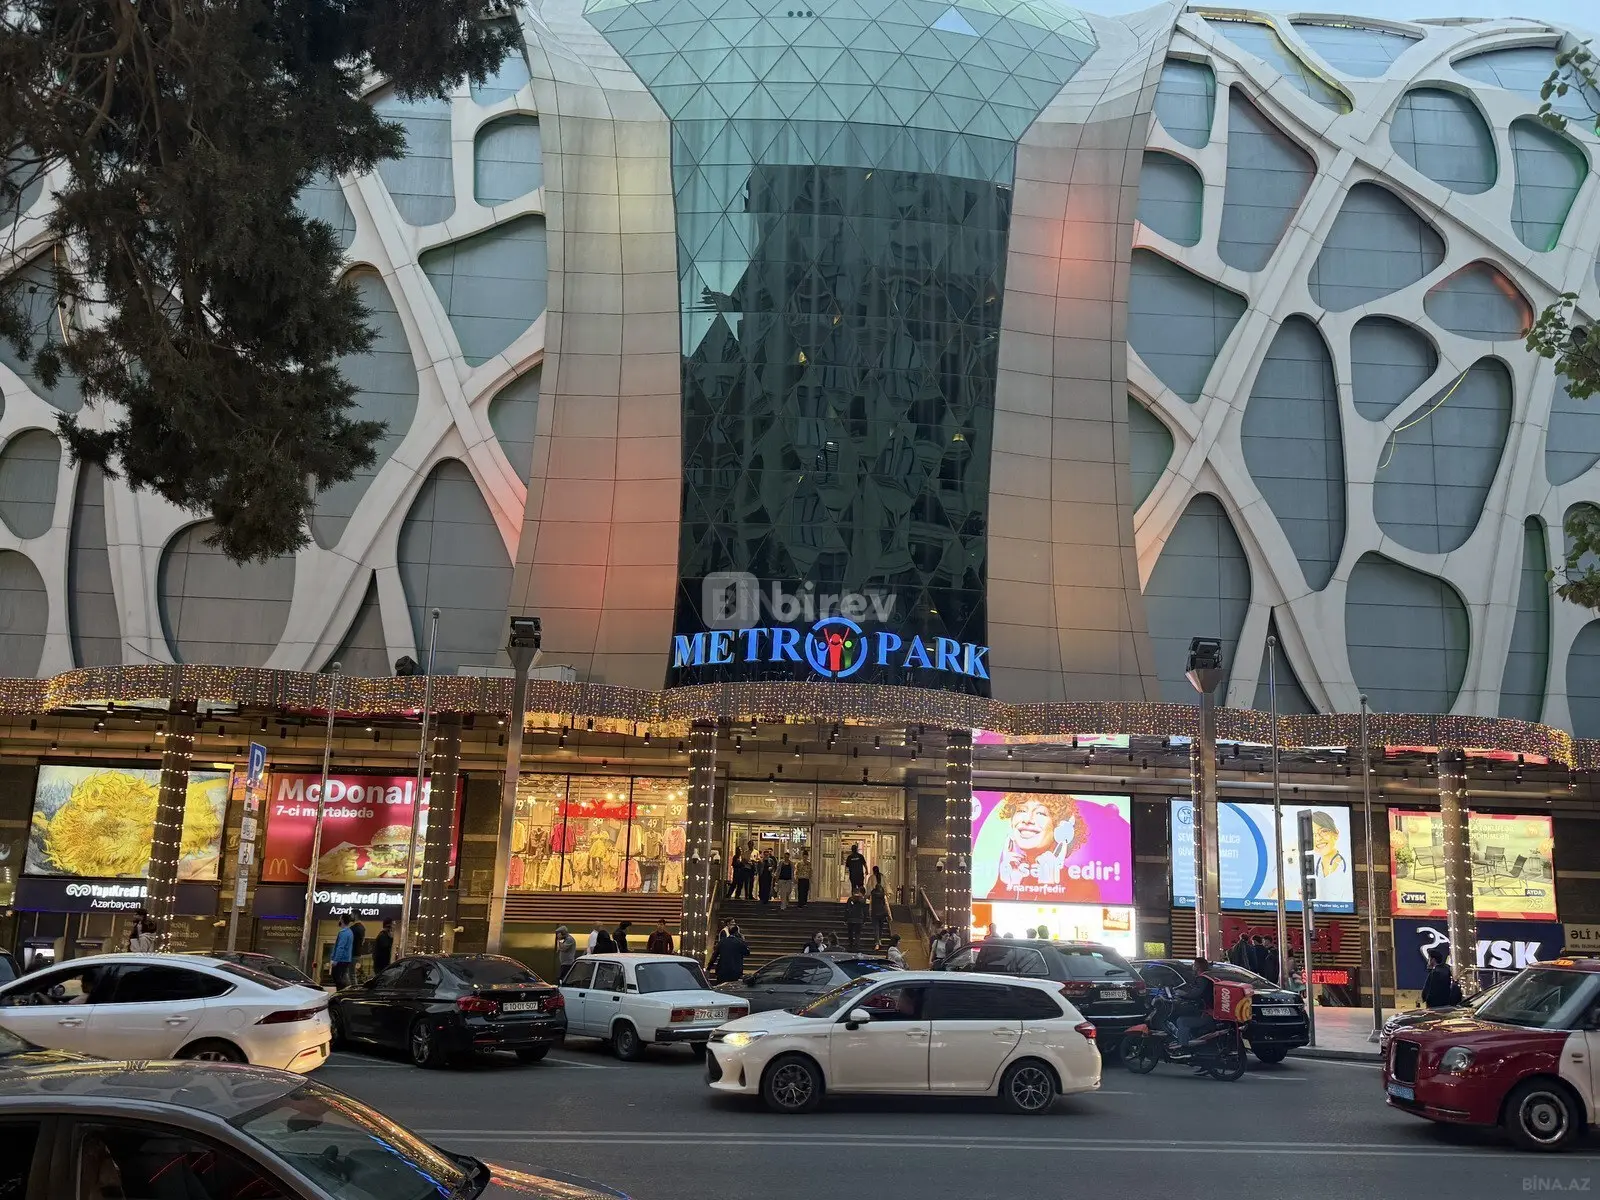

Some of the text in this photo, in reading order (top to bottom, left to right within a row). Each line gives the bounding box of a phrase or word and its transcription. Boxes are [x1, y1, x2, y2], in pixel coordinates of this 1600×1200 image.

[277, 778, 431, 805] McDonald
[276, 804, 374, 818] 7-ci mrtəbədə
[1067, 861, 1121, 882] edir!
[90, 899, 141, 910] Azərbaycan
[1476, 940, 1541, 969] YSK
